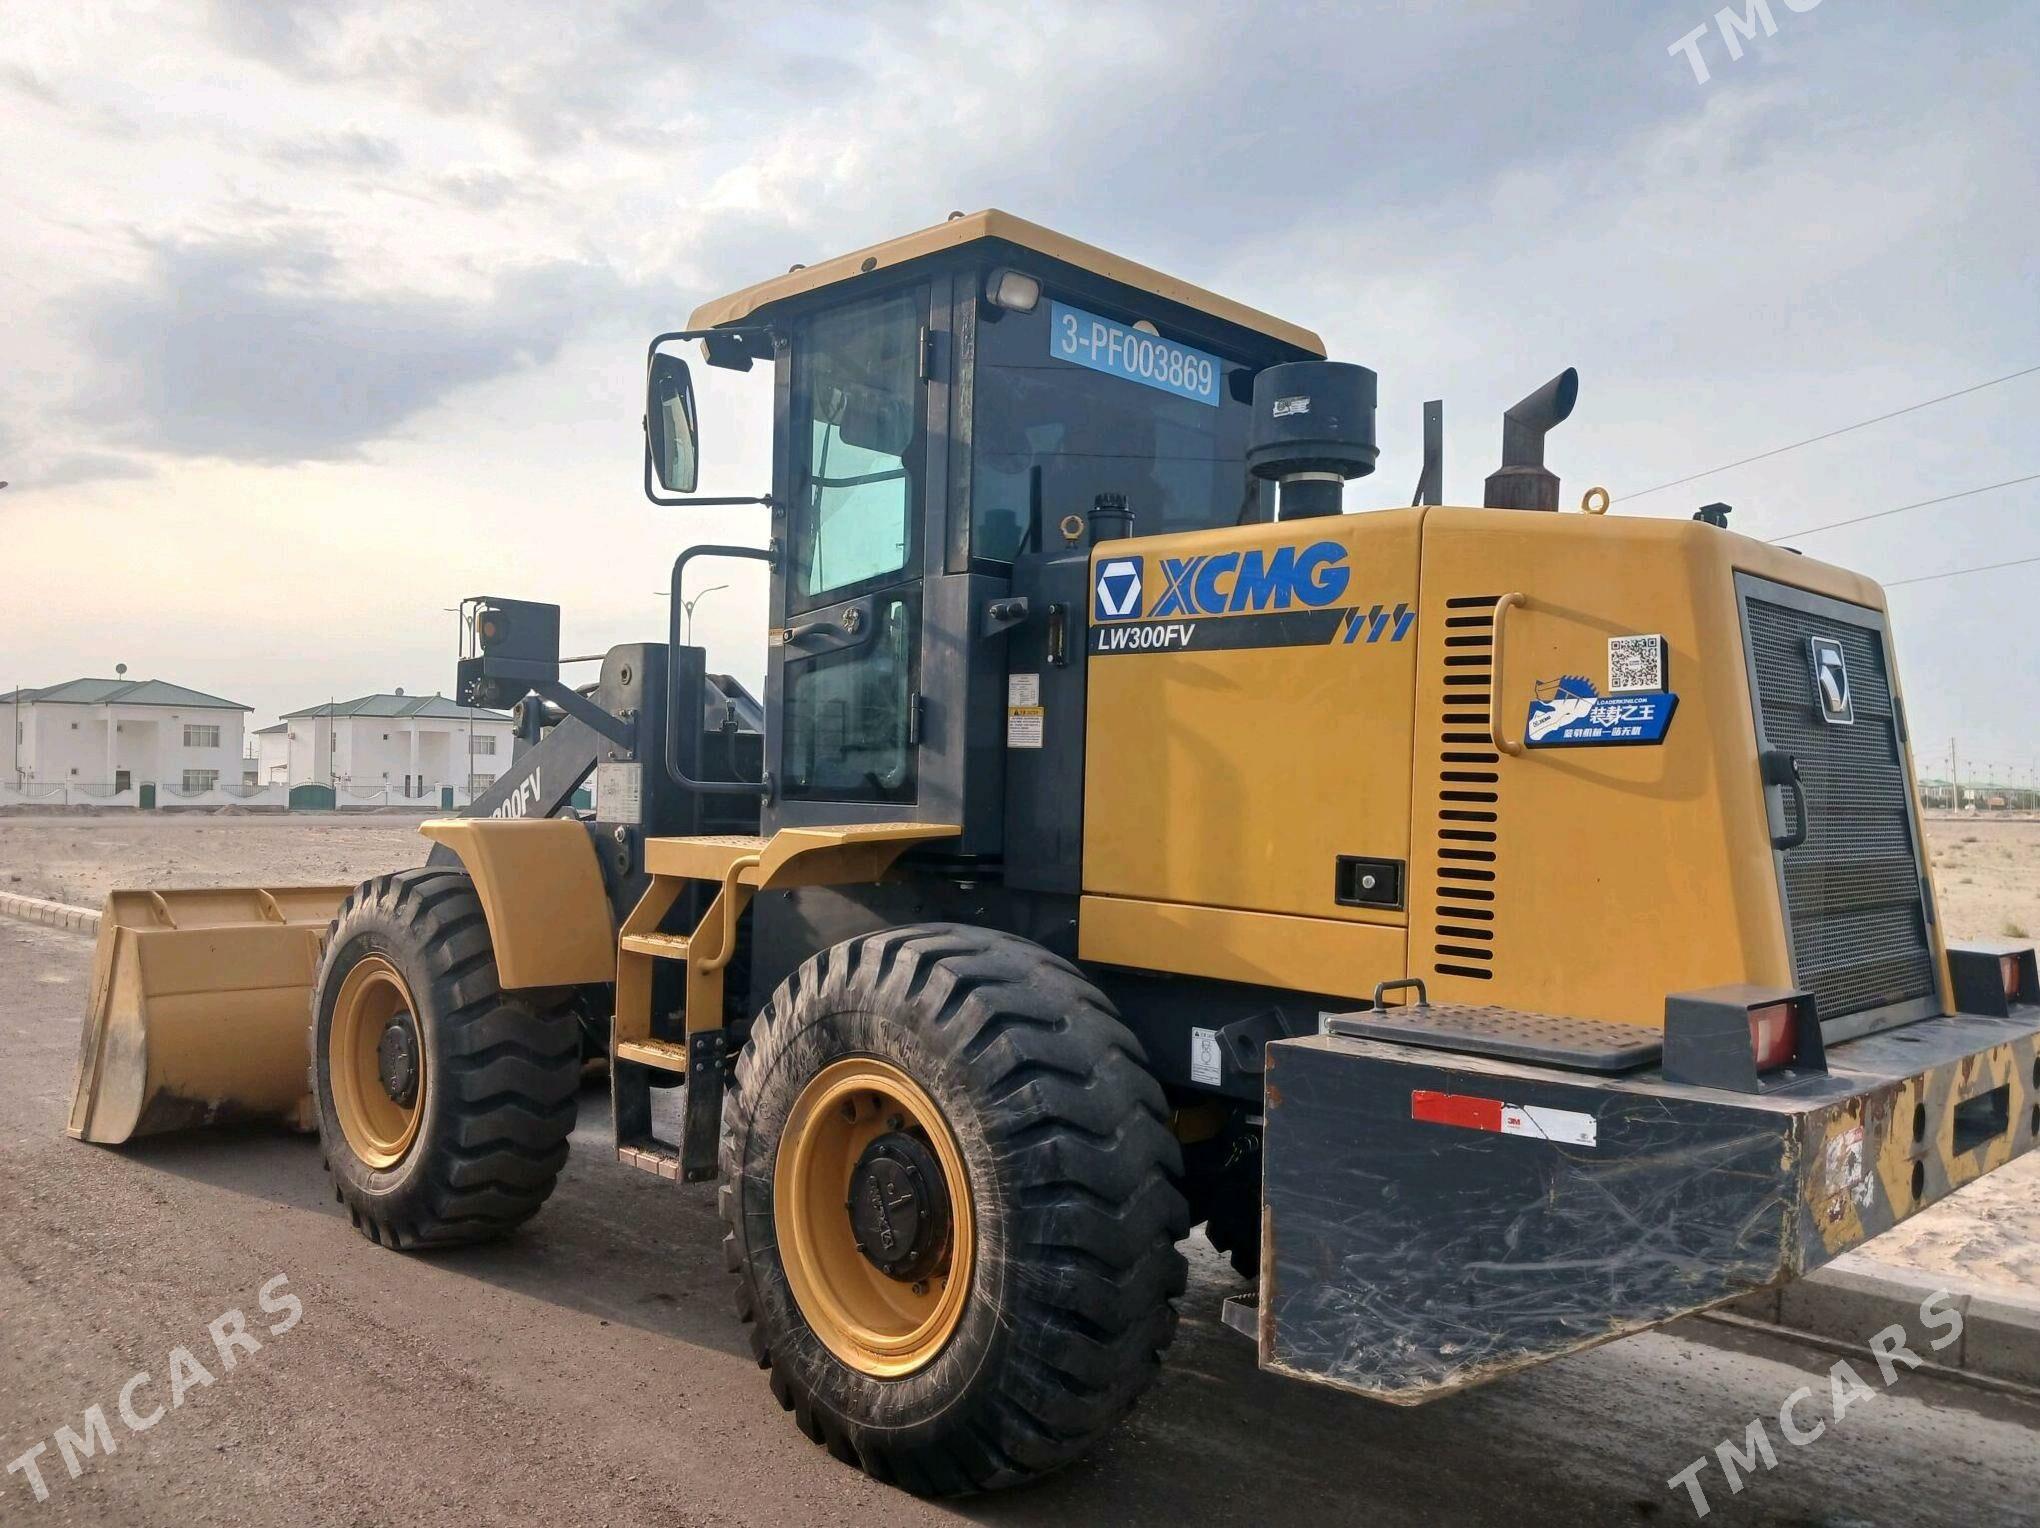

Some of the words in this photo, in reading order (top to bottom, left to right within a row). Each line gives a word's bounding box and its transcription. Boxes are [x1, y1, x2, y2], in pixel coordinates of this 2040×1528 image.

[1061, 314, 1213, 395] 3-PF003869
[1146, 542, 1350, 618] XCMG
[1098, 624, 1196, 650] LW300FV
[1508, 1117, 1521, 1125] 3M
